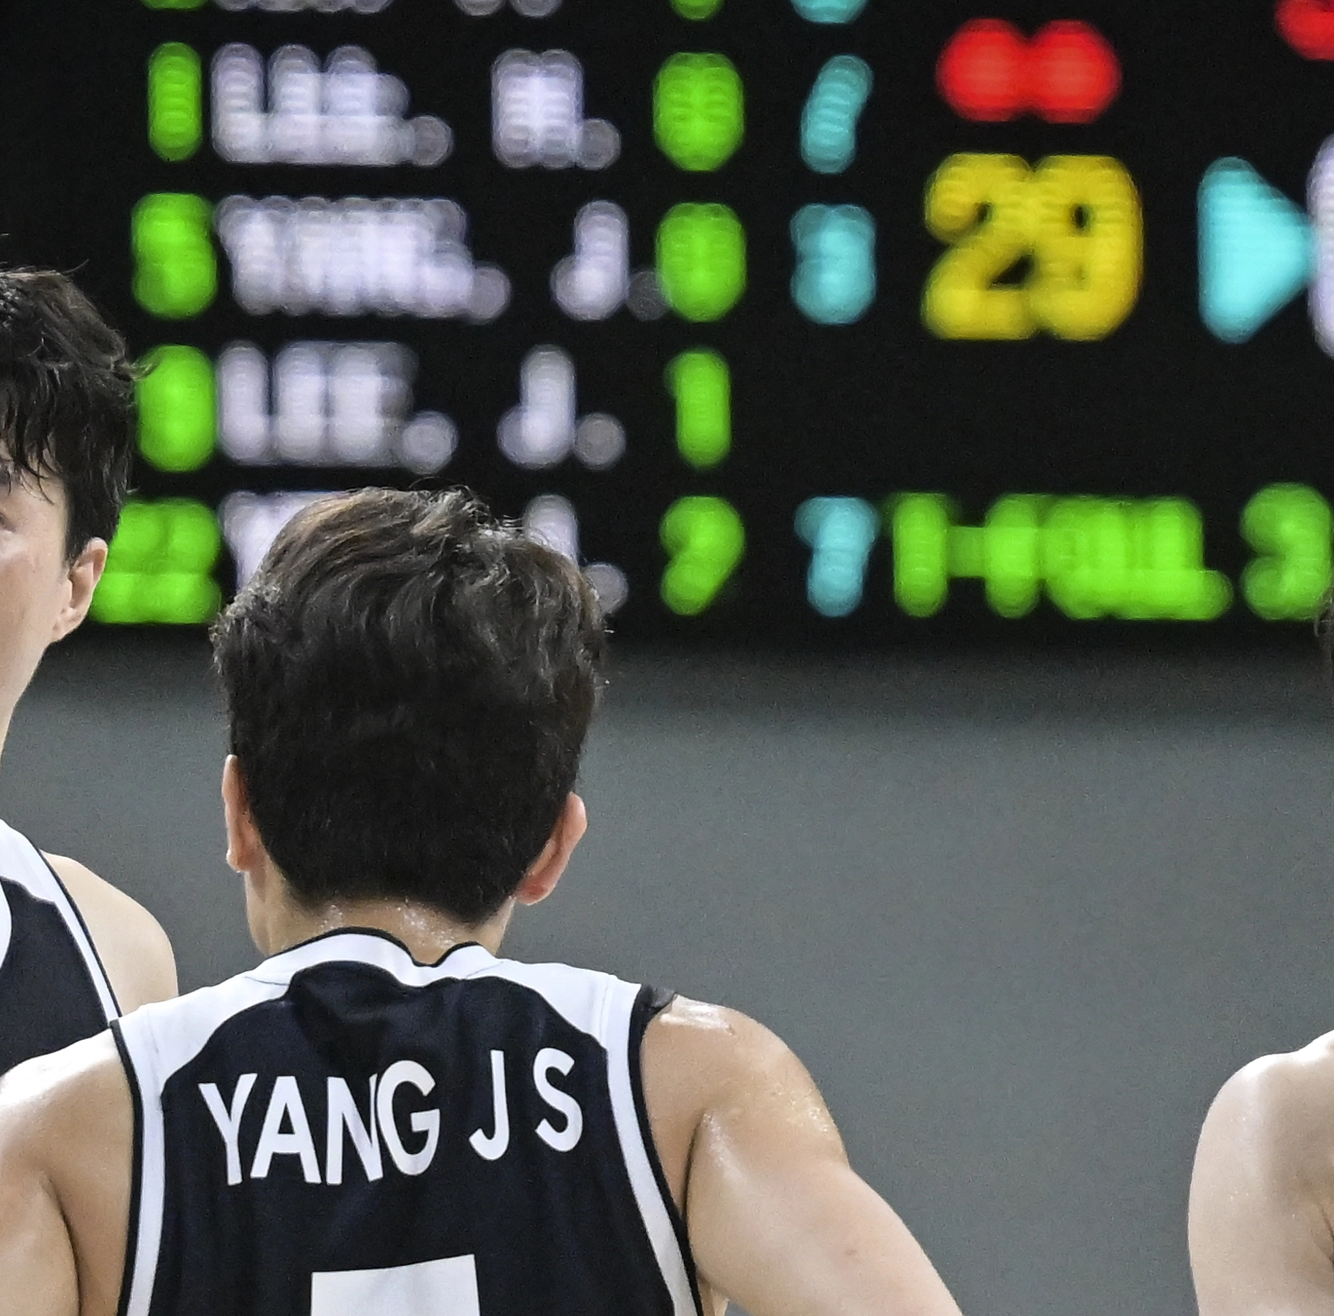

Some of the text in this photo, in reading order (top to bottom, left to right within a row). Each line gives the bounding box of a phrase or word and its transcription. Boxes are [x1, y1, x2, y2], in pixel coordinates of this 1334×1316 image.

[923, 153, 1143, 341] 29
[199, 1048, 584, 1186] YANG J S
